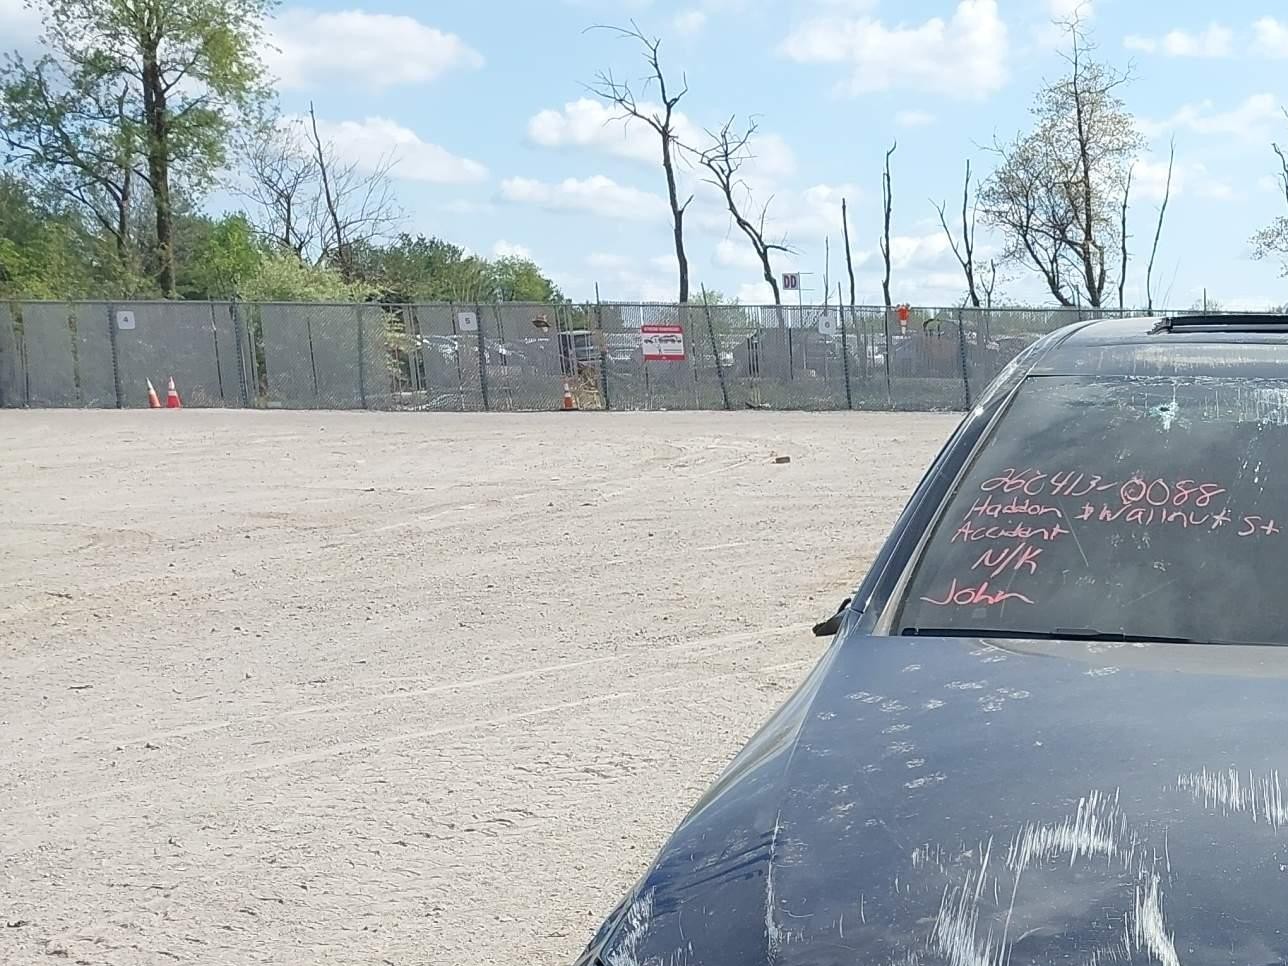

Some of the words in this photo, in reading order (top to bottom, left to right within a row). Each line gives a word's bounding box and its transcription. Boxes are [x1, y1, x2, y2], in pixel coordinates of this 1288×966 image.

[783, 275, 797, 289] DD
[963, 494, 1063, 521] Haddon
[1238, 515, 1280, 536] St
[951, 520, 1070, 544] Accident
[919, 577, 1035, 605] John
